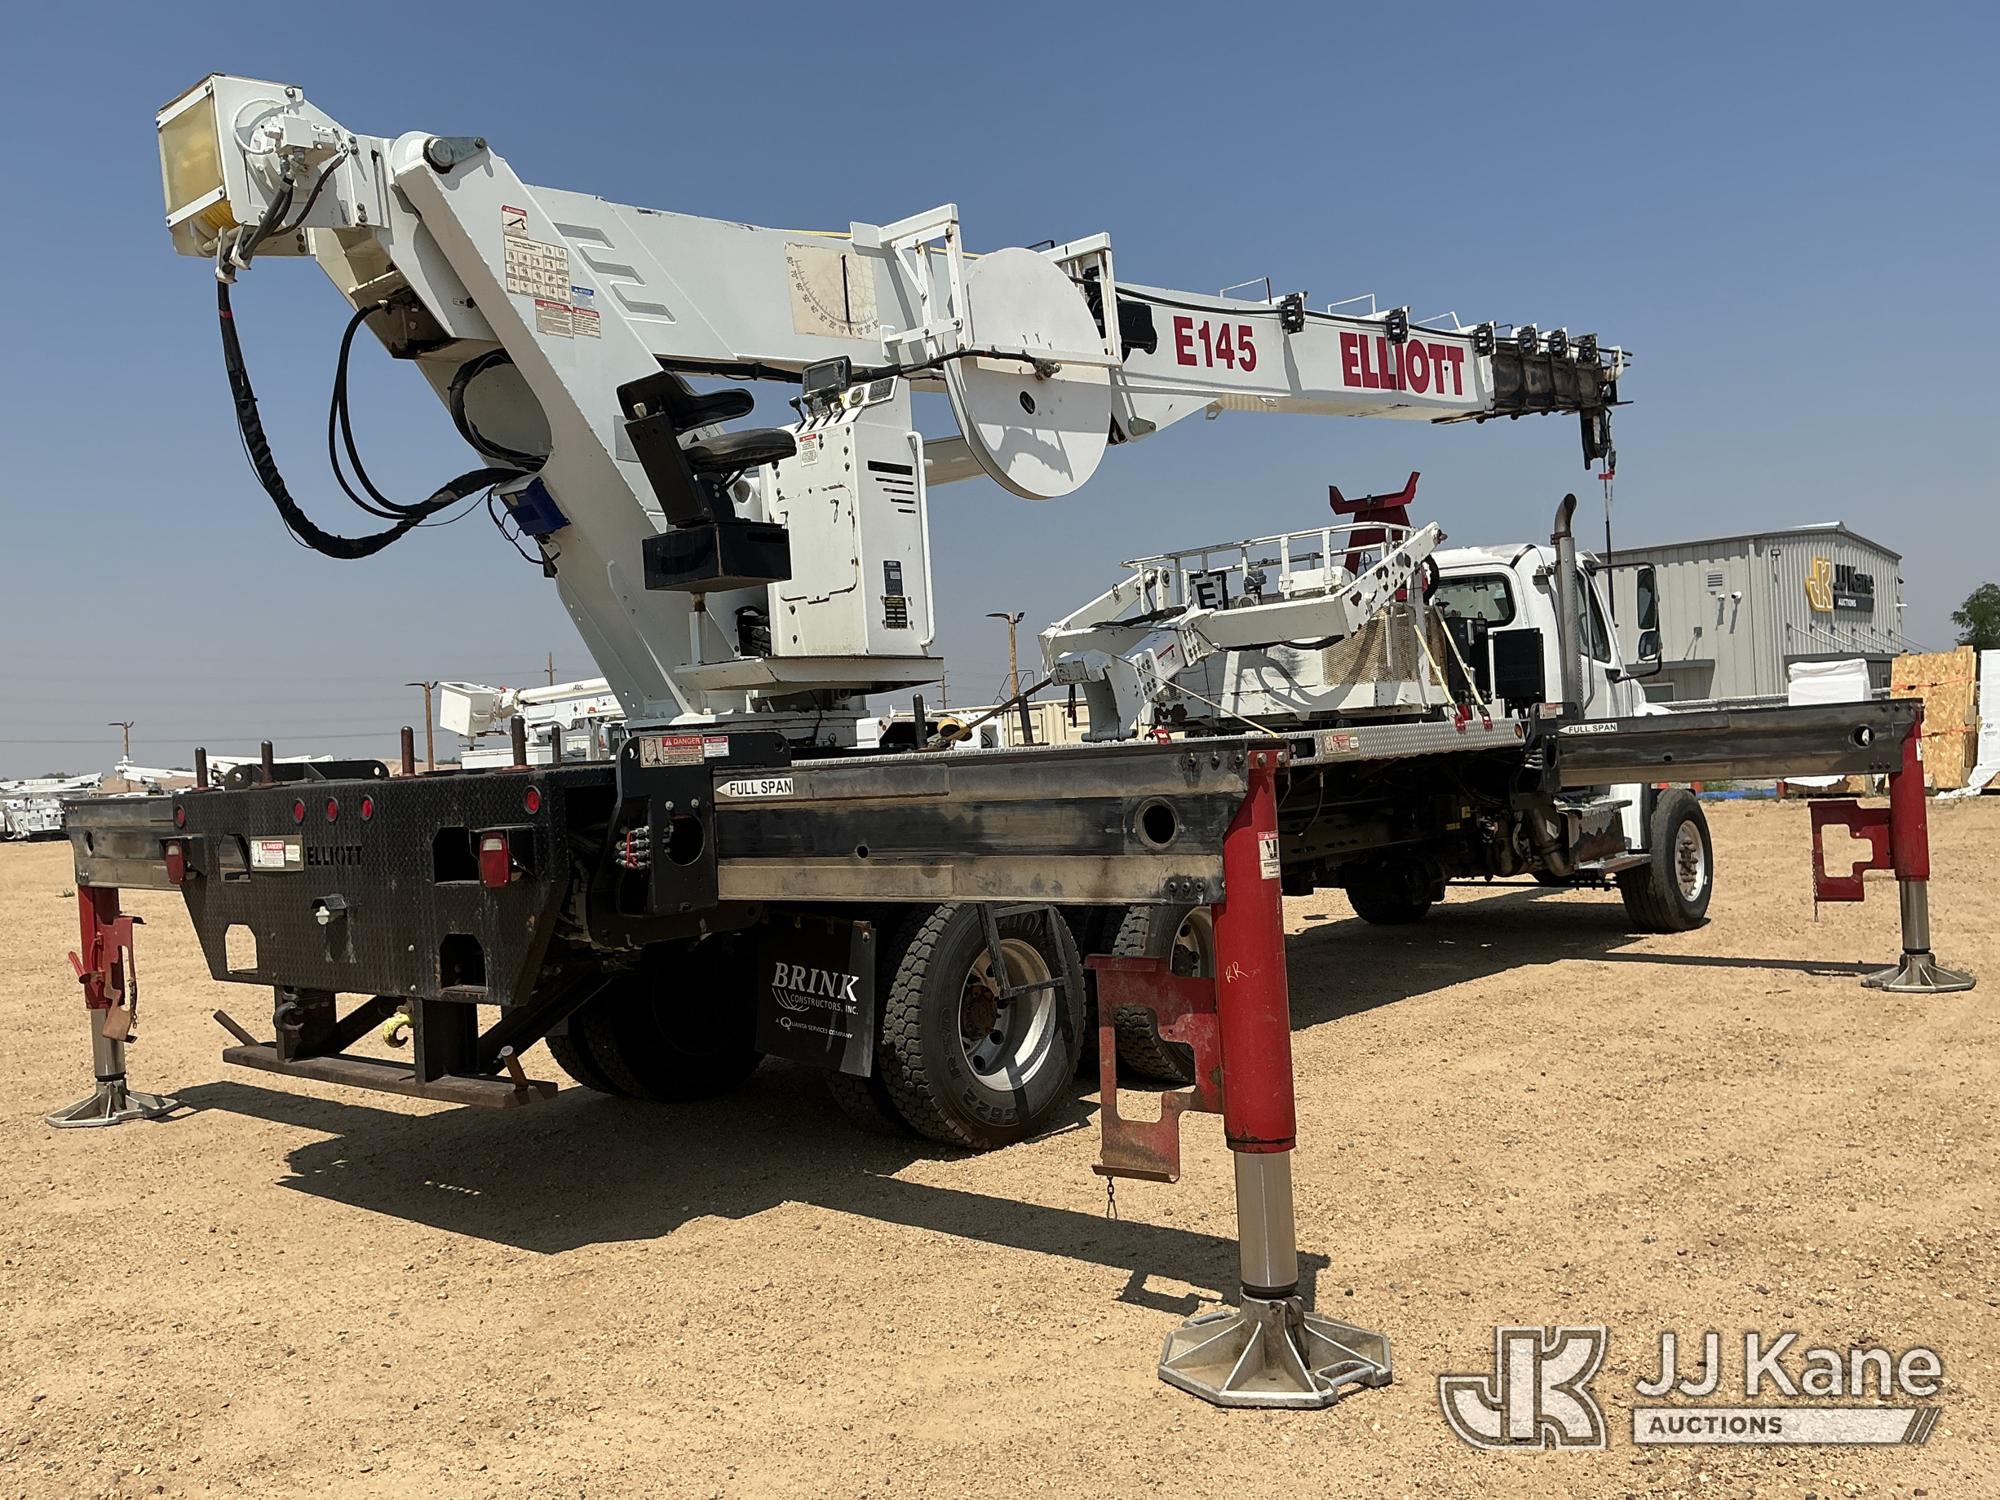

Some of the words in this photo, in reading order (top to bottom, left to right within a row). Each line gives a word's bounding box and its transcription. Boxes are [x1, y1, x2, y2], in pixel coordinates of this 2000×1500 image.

[1173, 315, 1257, 372] E145
[1339, 331, 1465, 396] ELLIOTT
[1593, 723, 1616, 732] SPAN
[673, 737, 700, 745] DANGER
[729, 780, 758, 796] FULL
[761, 779, 792, 795] SPAN
[307, 845, 362, 866] ELLIOTT
[772, 962, 860, 1002] BRINK
[1225, 961, 1248, 983] RR
